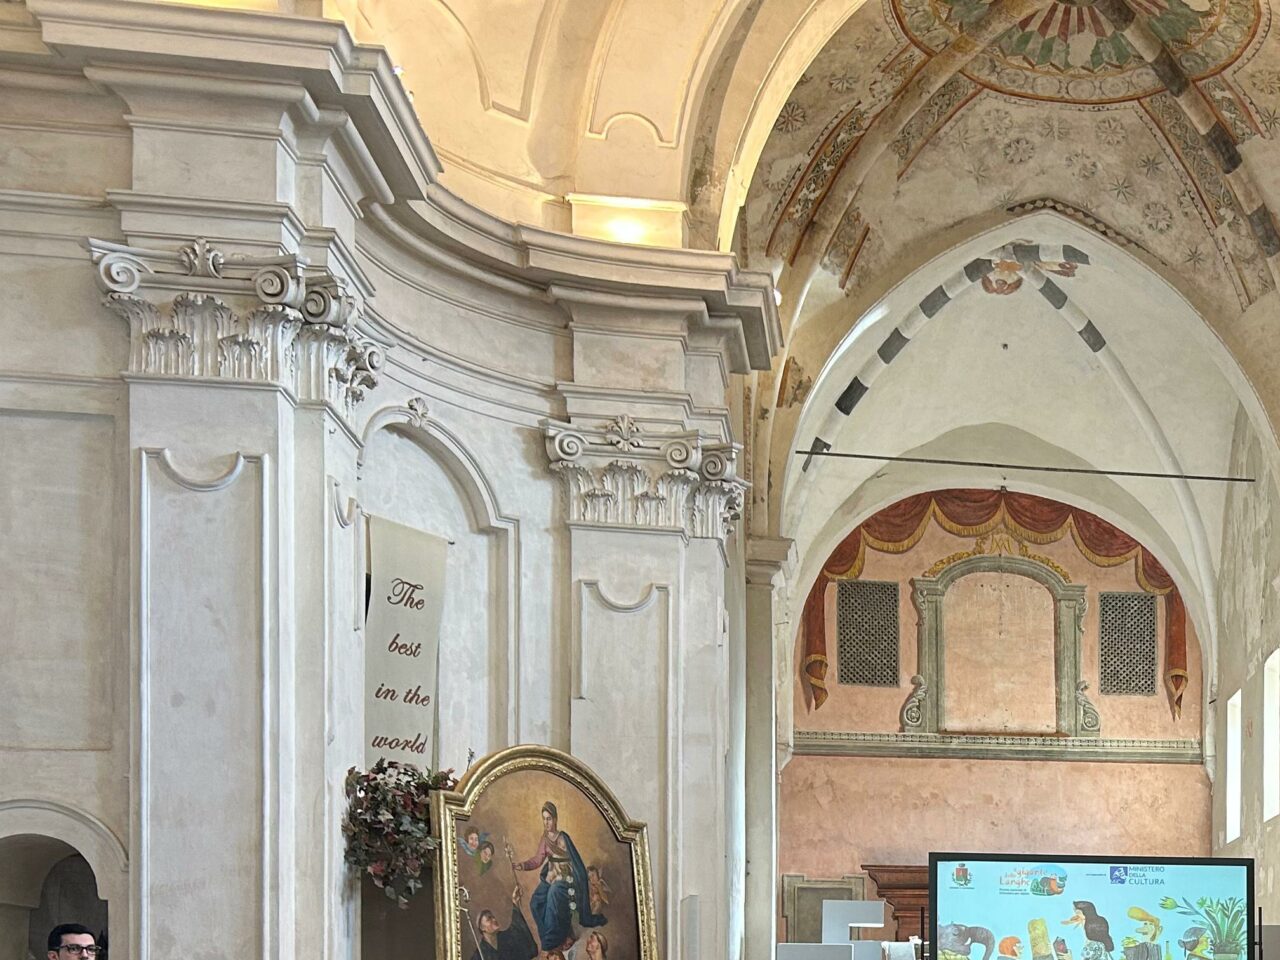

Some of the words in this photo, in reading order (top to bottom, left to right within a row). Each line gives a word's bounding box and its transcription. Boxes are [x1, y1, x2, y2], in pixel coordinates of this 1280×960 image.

[386, 577, 425, 610] The
[388, 633, 422, 658] best
[374, 683, 398, 701] in
[403, 685, 431, 707] the
[371, 733, 427, 754] world
